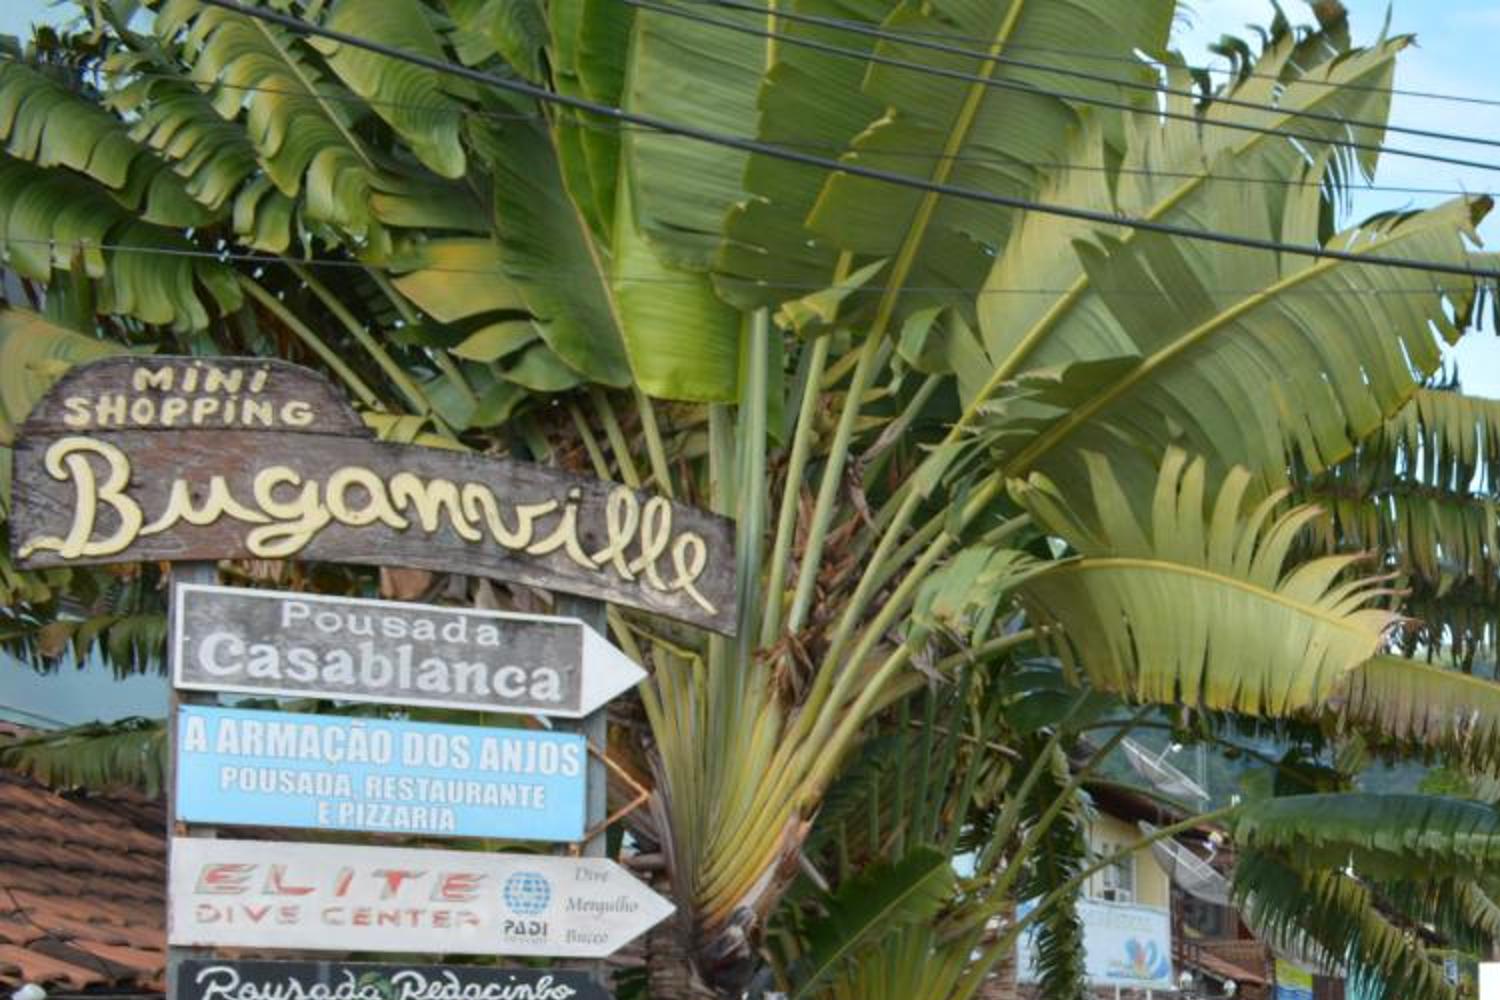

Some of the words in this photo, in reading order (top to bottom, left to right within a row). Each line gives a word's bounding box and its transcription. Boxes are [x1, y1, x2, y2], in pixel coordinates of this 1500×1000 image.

[18, 436, 719, 614] Buganville
[281, 600, 501, 647] Pousada
[198, 631, 563, 702] Casablanca
[185, 717, 207, 752] A
[217, 718, 391, 766] ARMAÇÃO
[403, 731, 470, 768] DOS
[479, 735, 580, 778] ANJOS
[365, 774, 545, 809] RESTAURANTE
[318, 803, 331, 825] E
[338, 803, 456, 832] PIZZARIA
[194, 864, 489, 902] ELITE
[196, 904, 300, 925] DIVE
[321, 907, 481, 929] CENTER
[504, 919, 548, 937] PADI
